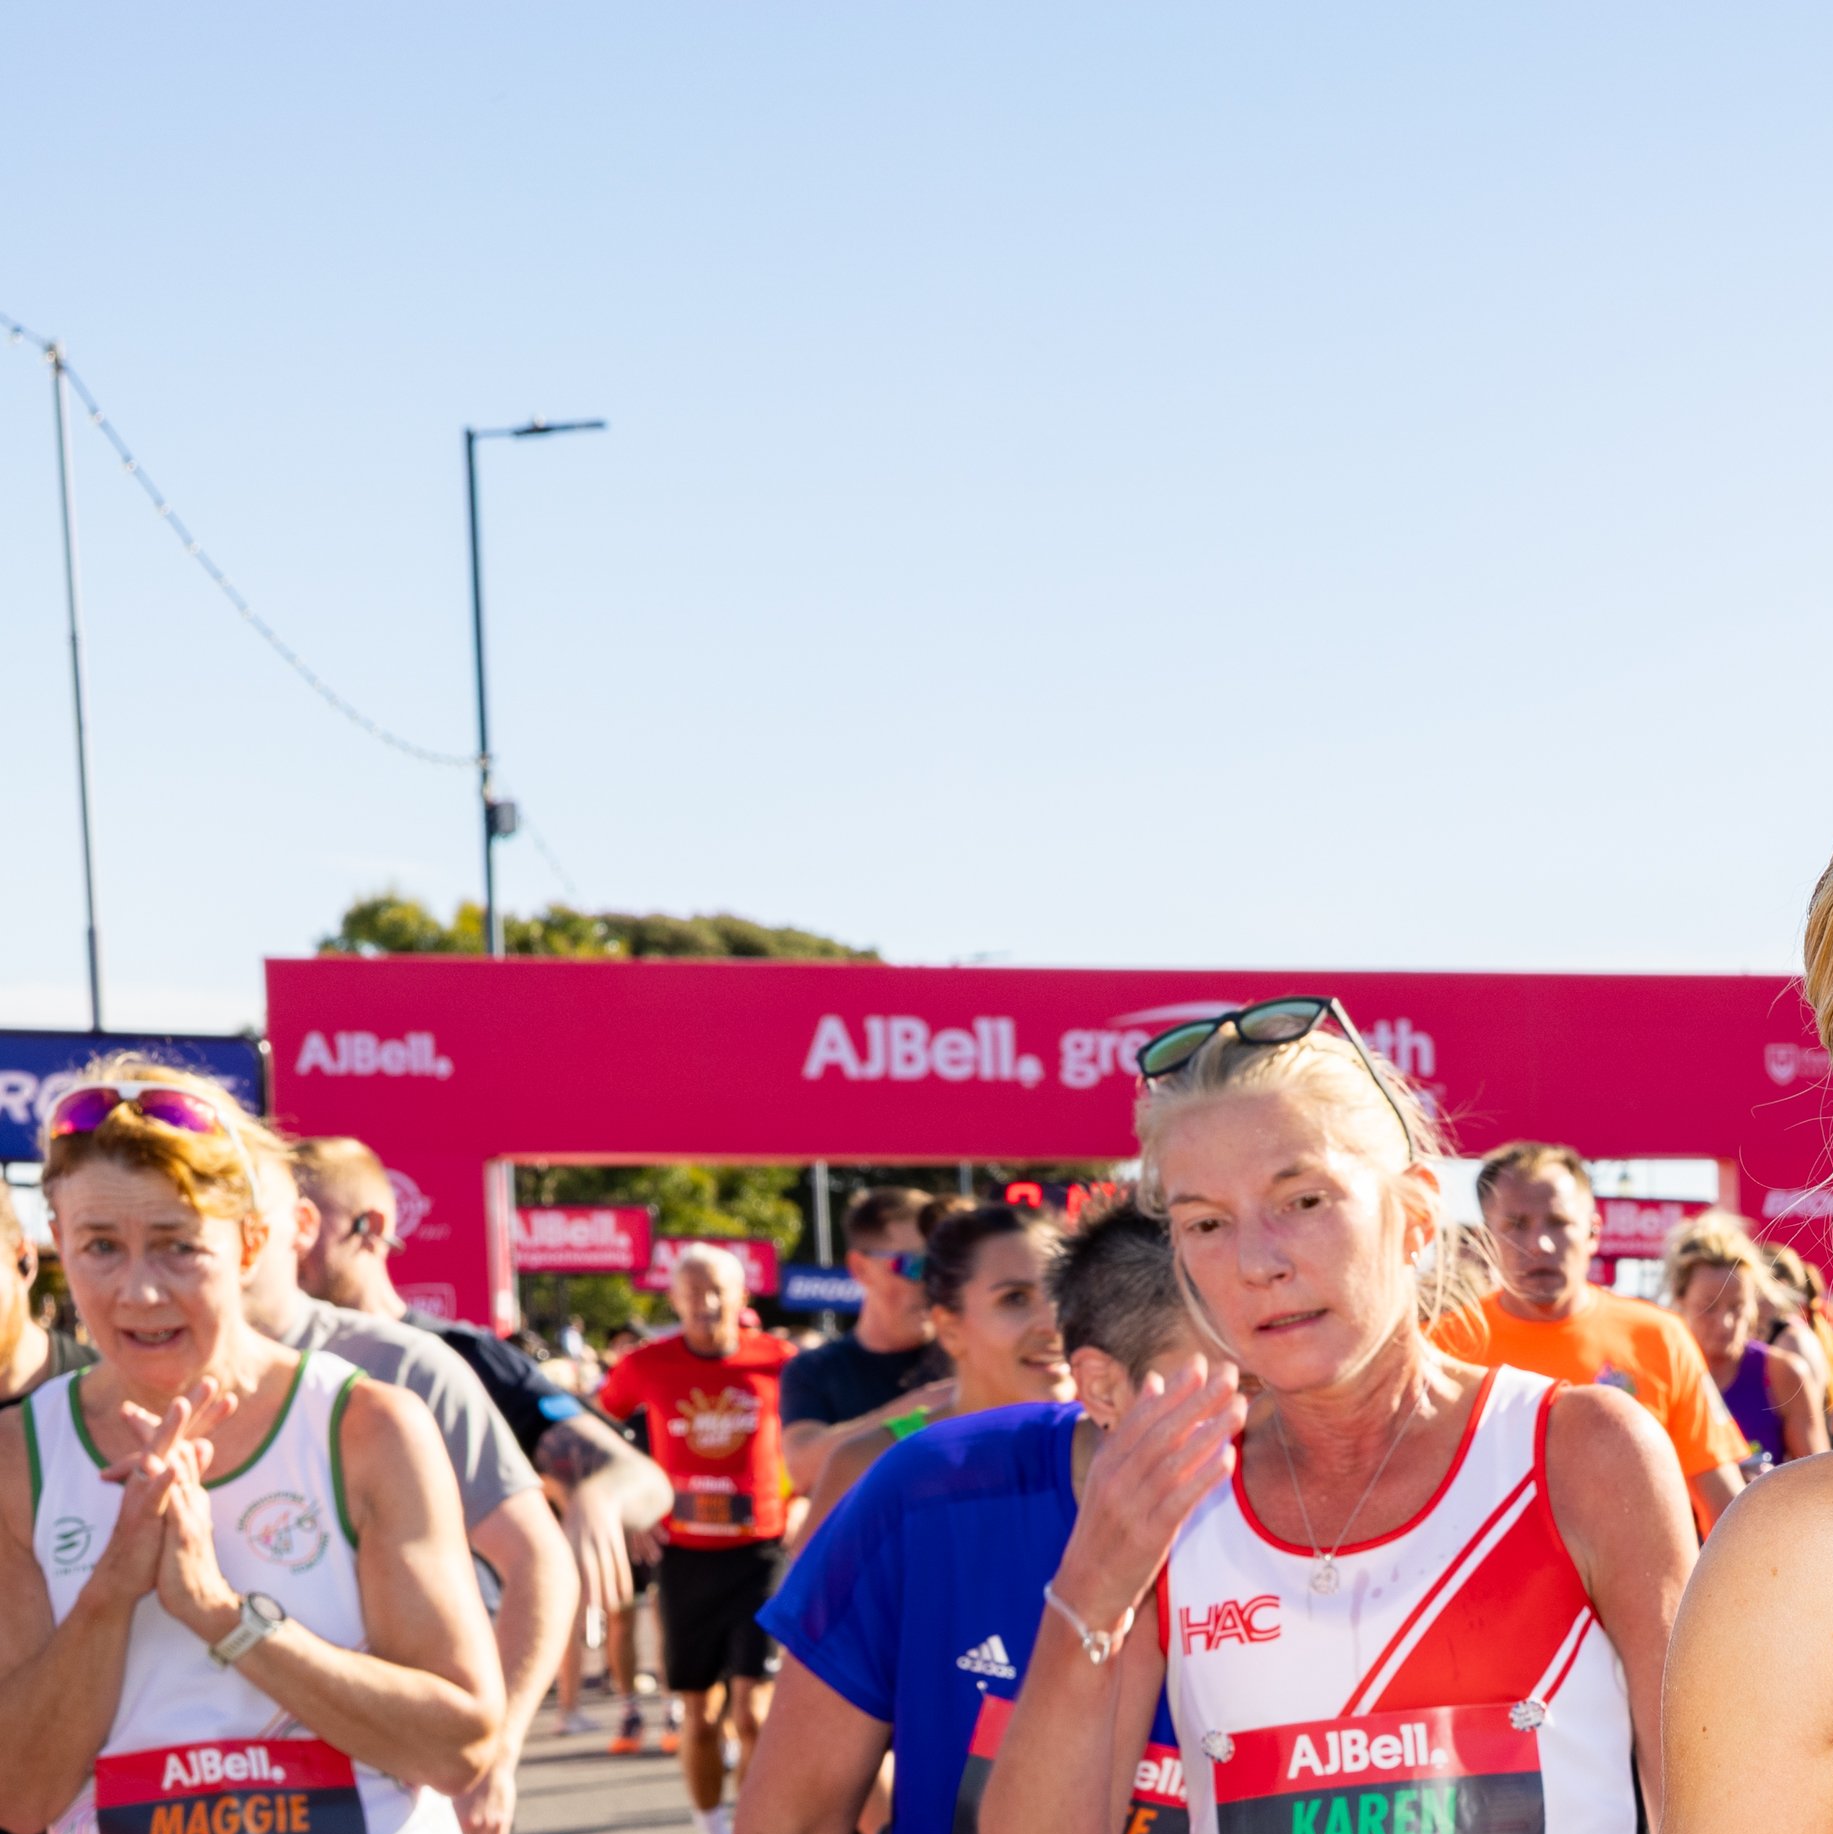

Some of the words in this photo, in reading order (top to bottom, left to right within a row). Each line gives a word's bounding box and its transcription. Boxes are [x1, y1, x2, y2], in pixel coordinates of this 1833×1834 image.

[802, 1014, 1016, 1081] AJBell
[1179, 1595, 1282, 1656] HAC
[162, 1747, 269, 1791] AJBell
[1286, 1722, 1429, 1780] AJBell
